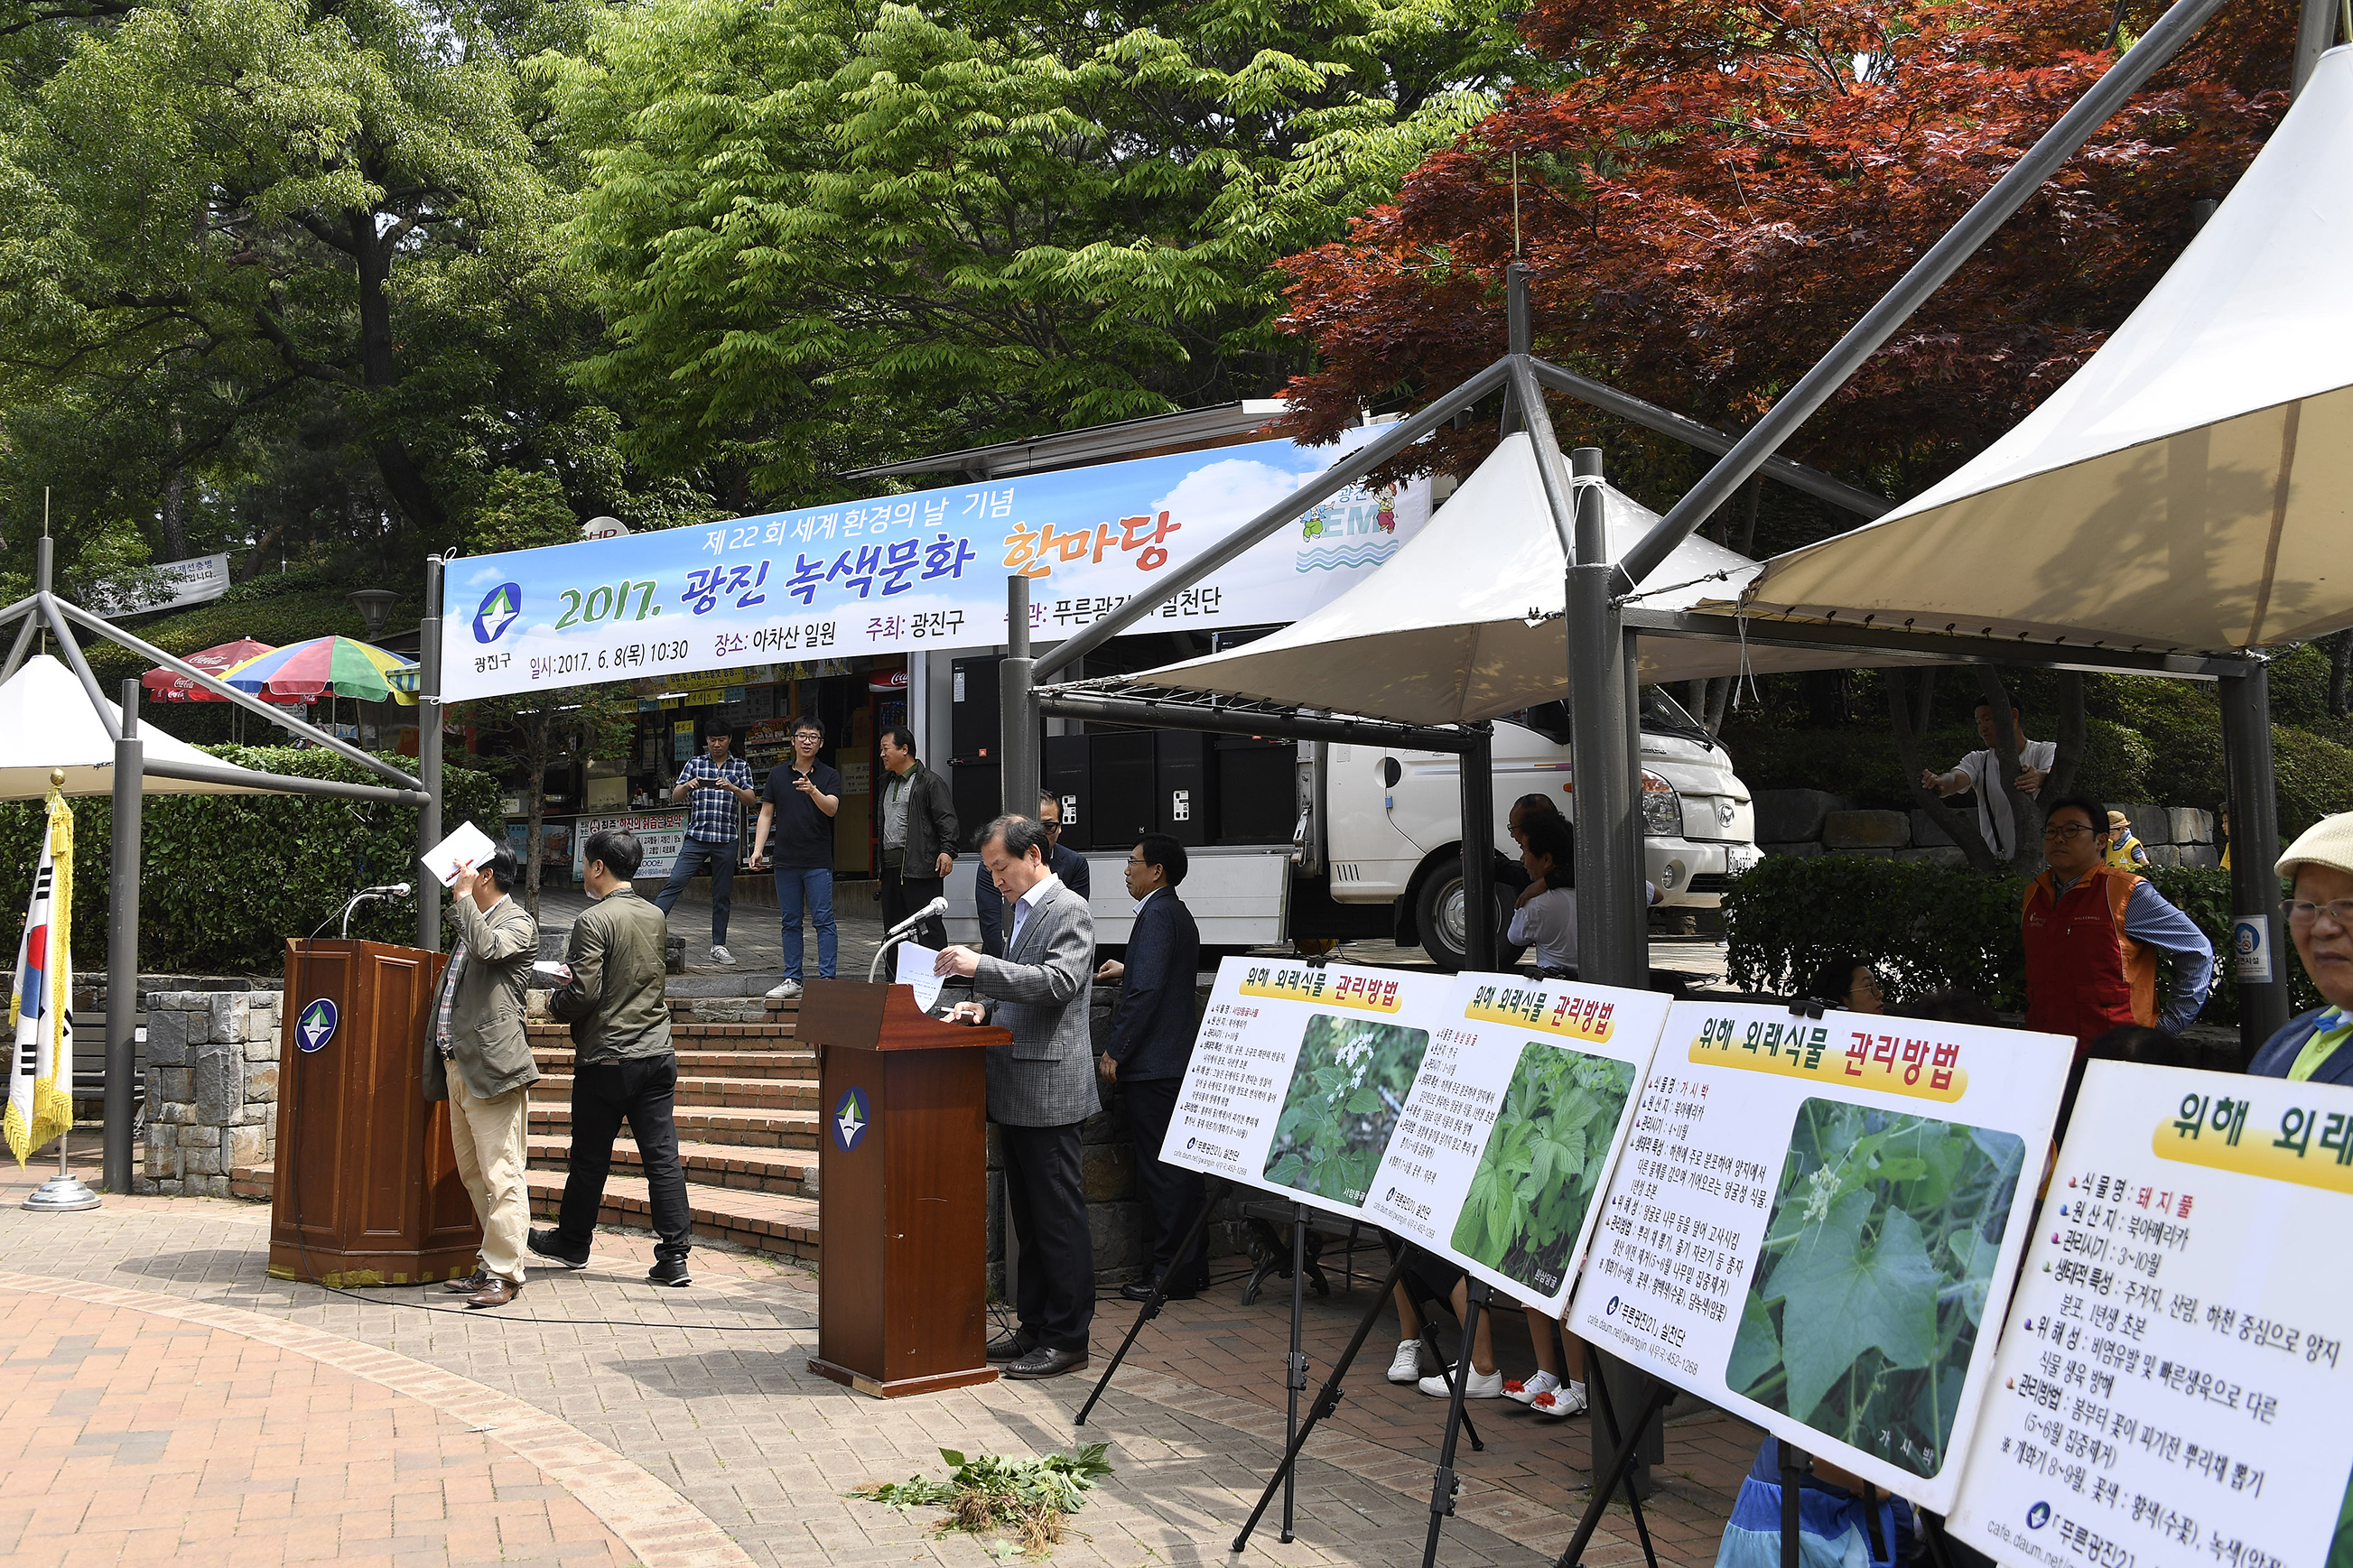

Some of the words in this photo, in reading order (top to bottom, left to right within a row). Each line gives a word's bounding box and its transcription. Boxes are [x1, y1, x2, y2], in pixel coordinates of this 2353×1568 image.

[923, 496, 950, 527] 날
[962, 487, 1015, 519] 기념
[554, 580, 662, 632] 2017.
[681, 557, 771, 617] 광진
[785, 532, 976, 605] 녹색문화
[1002, 509, 1181, 580] 한마당
[1162, 586, 1222, 618] 실천단
[713, 633, 749, 658] 장소:
[752, 625, 800, 654] 아차산
[804, 620, 836, 648] 일원
[866, 614, 906, 640] 주최:
[910, 608, 966, 639] 광진구
[474, 650, 513, 673] 광진구
[650, 638, 689, 663] 10:30
[1246, 968, 1270, 987] 위해
[1275, 970, 1326, 997] 외래식물
[1335, 976, 1399, 1007] 관리방법
[1473, 986, 1496, 1009] 위해
[1497, 988, 1548, 1023] 외래식물
[1551, 996, 1614, 1035] 관리방법
[1699, 1018, 1735, 1051] 위해
[1742, 1021, 1828, 1070] 외래식물
[1845, 1032, 1959, 1090] 관리방법
[1674, 1101, 1705, 1121] 북아메리카
[2173, 1094, 2249, 1146] 위해
[1637, 1158, 1650, 1175] 다른
[1667, 1166, 1688, 1186] 감으며
[1688, 1172, 1721, 1196] 기어오르는
[1724, 1182, 1748, 1203] 덩굴성
[1688, 1149, 1703, 1165] 주로
[1704, 1153, 1734, 1175] 분포하여
[1735, 1160, 1767, 1183] 양지에서
[1643, 1204, 1661, 1223] 덩굴로
[1662, 1211, 1676, 1229] 나무
[1676, 1215, 1691, 1235] 등을
[1707, 1226, 1740, 1251] 고사시킴
[2127, 1216, 2189, 1251] 북아메리카
[1675, 1239, 1691, 1258] 줄기
[1691, 1245, 1715, 1267] 자르기
[1716, 1252, 1725, 1271] 등
[1726, 1256, 1744, 1277] 종자
[2063, 1229, 2108, 1261] 관리시기
[2117, 1247, 2162, 1278] 3~10월
[1587, 1314, 1647, 1351] cafe.daum.net/gwangjin
[1660, 1323, 1686, 1348] 실천단
[2088, 1267, 2114, 1295] 특성
[2207, 1305, 2236, 1335] 하천
[2238, 1314, 2300, 1353] 중심으로
[2306, 1334, 2340, 1368] 양지
[2119, 1313, 2146, 1341] 초본
[2040, 1350, 2061, 1378] 식물
[2064, 1360, 2087, 1387] 생육
[2089, 1370, 2115, 1399] 방해
[2091, 1337, 2140, 1374] 비염유발
[2142, 1355, 2156, 1380] 및
[2246, 1393, 2277, 1424] 다른
[2018, 1374, 2062, 1411] 관리방법
[2071, 1396, 2108, 1432] 봄부터
[2110, 1413, 2137, 1443] 꽃이
[2140, 1425, 2181, 1462] 피기전
[2184, 1443, 2228, 1482] 뿌리채
[2231, 1463, 2264, 1498] 뽑기
[2065, 1429, 2116, 1469] 집중제거)
[2015, 1441, 2047, 1473] 개화기
[2093, 1477, 2119, 1508] 꽃색
